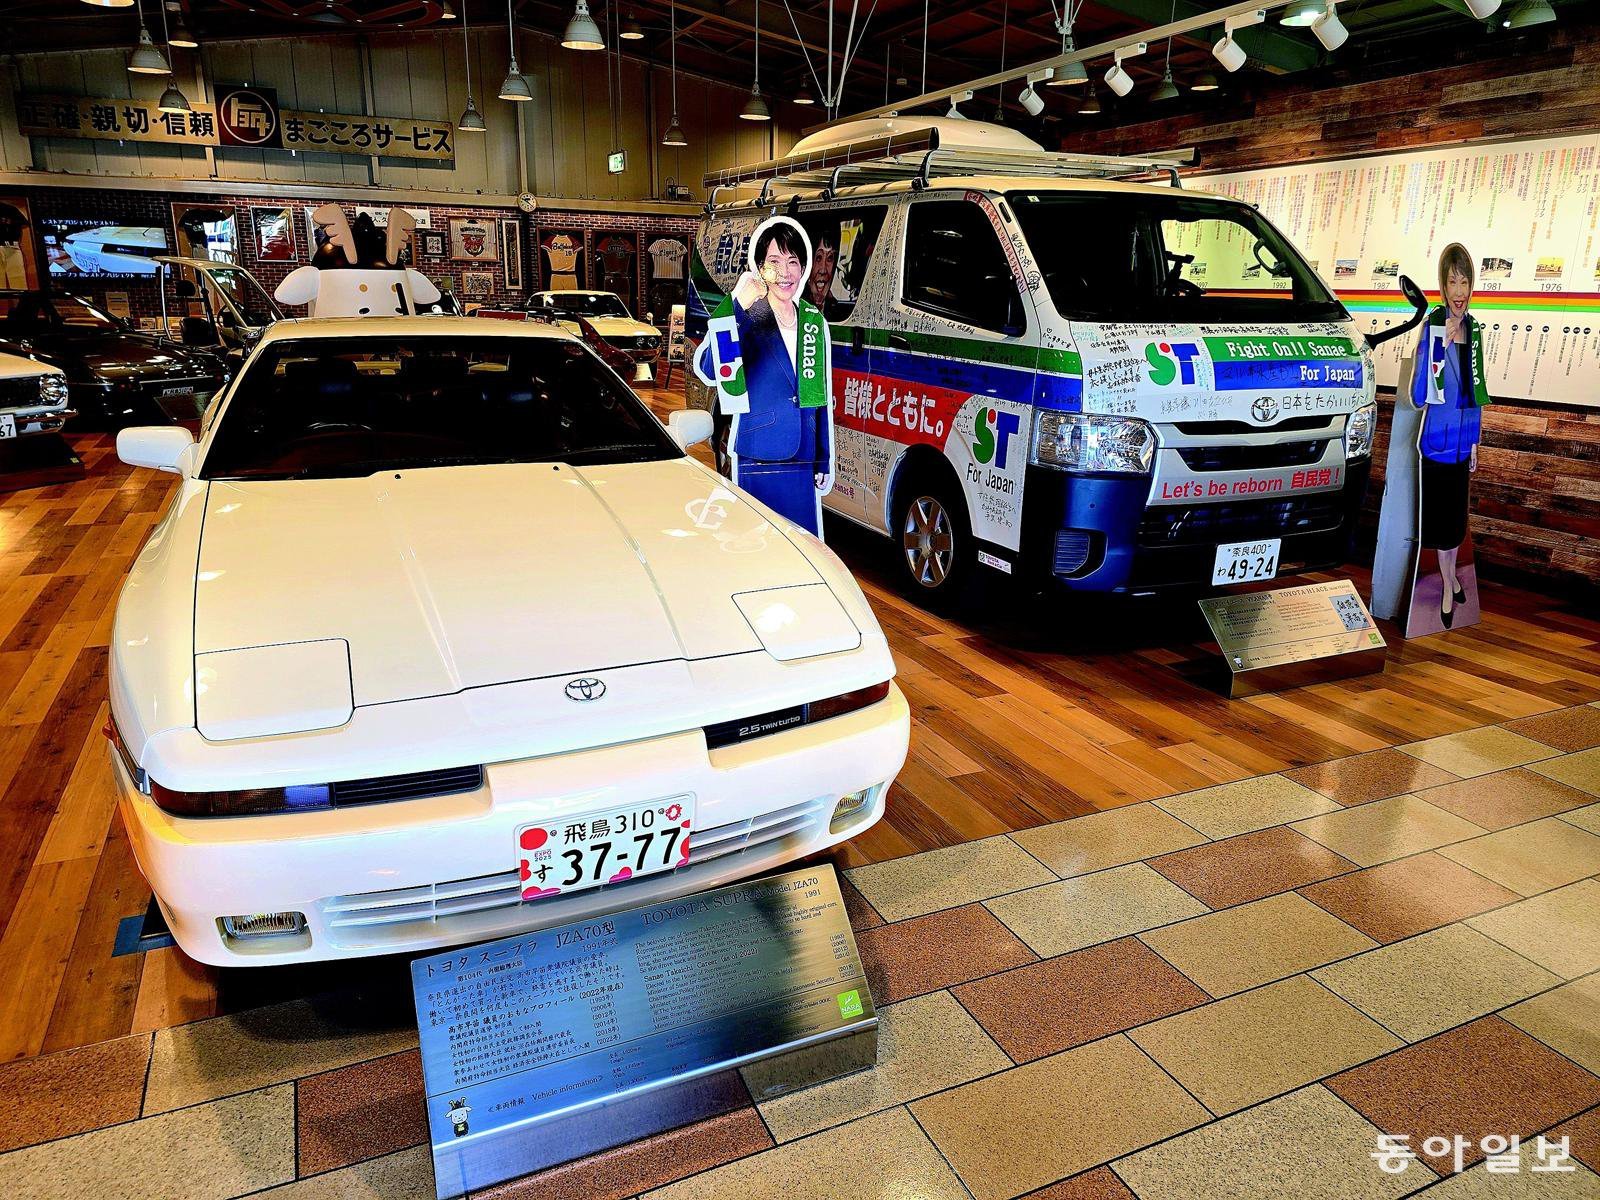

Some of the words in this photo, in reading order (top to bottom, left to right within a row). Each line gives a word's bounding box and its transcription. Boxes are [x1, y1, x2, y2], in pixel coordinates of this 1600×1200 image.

[18, 104, 216, 138] 正確・親切・信頼
[284, 117, 452, 154] まごころサービス
[1373, 281, 1391, 289] 1987
[1482, 282, 1502, 291] 1981
[1541, 283, 1562, 292] 1976
[802, 322, 819, 380] Sanae
[1225, 340, 1271, 359] Fight
[1272, 339, 1307, 357] On!!
[1307, 341, 1347, 358] Sanae
[1145, 342, 1200, 386] ST
[1299, 365, 1320, 382] For
[1324, 365, 1356, 383] Japan
[844, 377, 944, 438] 皆様とともに。
[973, 407, 1020, 470] ST
[966, 463, 982, 484] For
[985, 469, 1014, 495] Japan
[1162, 480, 1204, 500] Let's
[1207, 478, 1228, 497] be
[1231, 476, 1283, 496] reborn
[1232, 546, 1250, 557] 奈良
[1250, 543, 1267, 555] 400
[1227, 556, 1275, 580] 49-24
[1278, 588, 1306, 599] TOYOTA
[739, 723, 761, 737] 2.5
[760, 721, 778, 731] TWIN
[778, 715, 801, 726] turbo
[564, 819, 611, 845] 飛鳥
[614, 809, 655, 834] 310
[534, 849, 552, 858] EXPO
[560, 827, 682, 887] 37-77
[533, 863, 553, 884] す
[640, 898, 709, 926] TOYOTA
[711, 885, 764, 909] SUPRA
[766, 881, 791, 896] Model
[791, 876, 819, 890] JZA70
[803, 887, 821, 899] 1991
[426, 955, 469, 977] トヨタ
[477, 939, 538, 965] スープラ
[553, 919, 616, 948] JZA70型
[581, 936, 618, 953] 1991年式
[643, 971, 664, 983] Sanae
[664, 963, 694, 977] Takaichi
[695, 957, 718, 969] Career
[447, 1018, 480, 1034] 高市早苗
[482, 993, 575, 1025] 議員のおもなプロフィール
[841, 1003, 862, 1015] NARA
[530, 1087, 558, 1102] Vehicle
